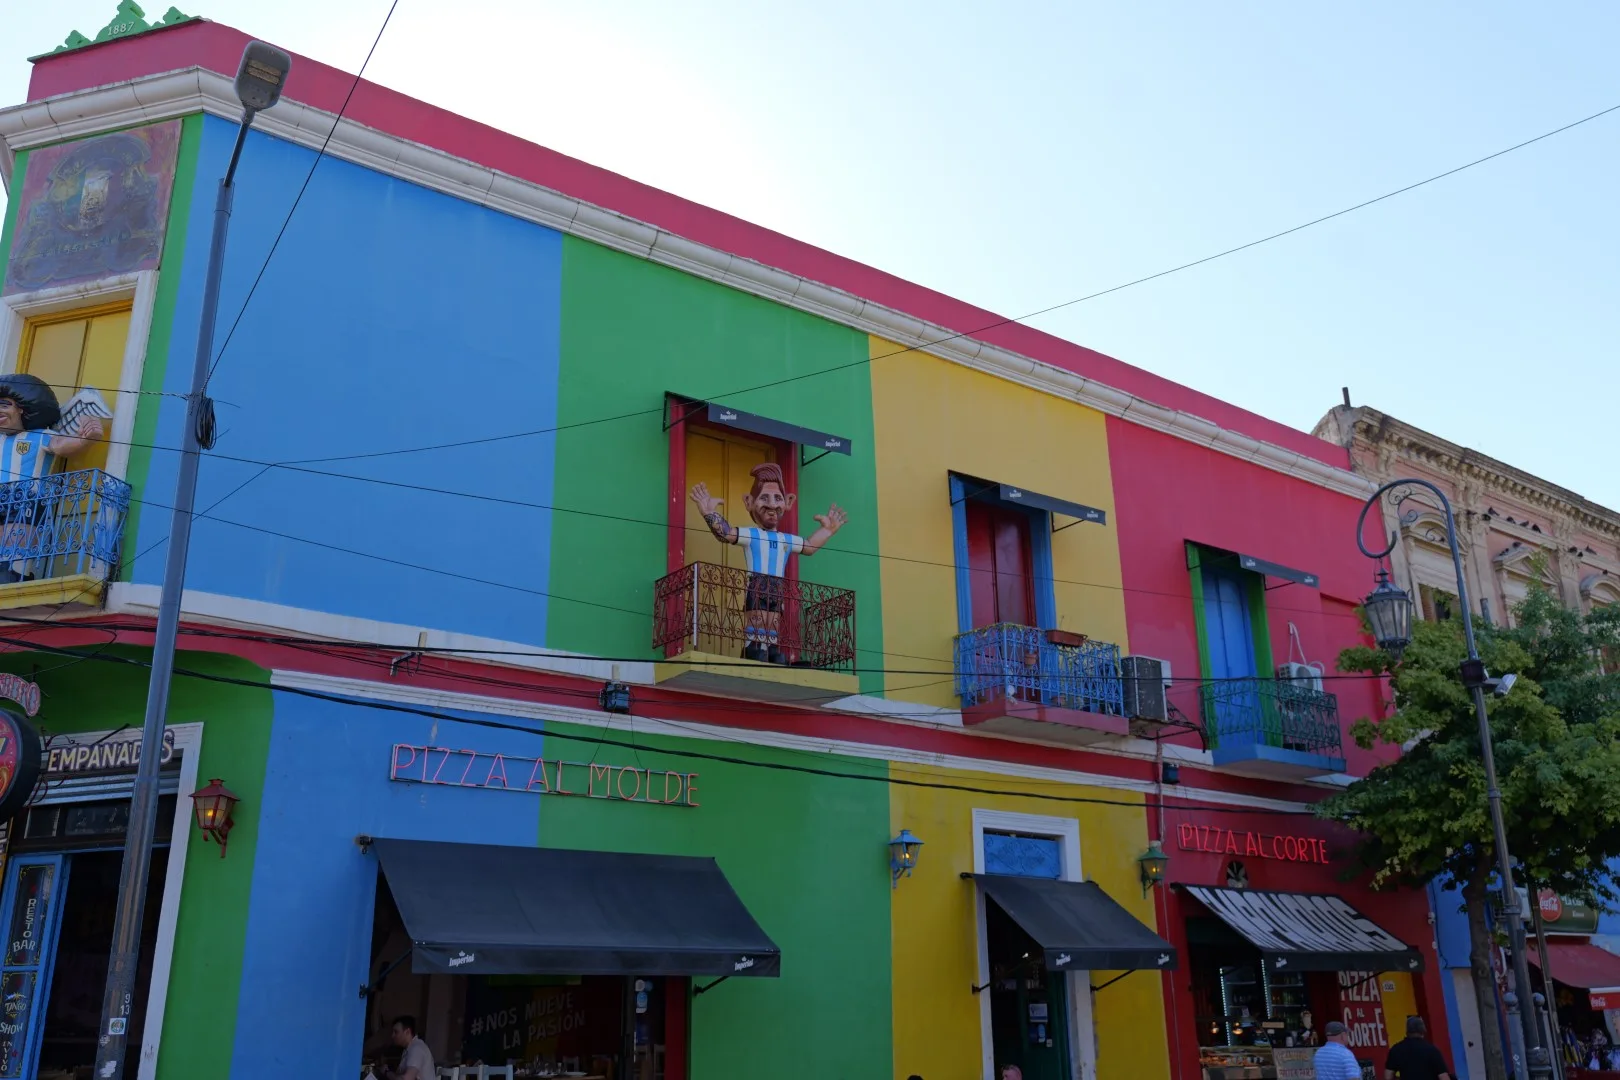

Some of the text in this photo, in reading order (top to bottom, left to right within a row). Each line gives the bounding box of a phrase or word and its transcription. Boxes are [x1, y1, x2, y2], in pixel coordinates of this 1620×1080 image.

[107, 21, 135, 36] 1887
[769, 541, 778, 549] 10
[47, 729, 174, 772] EMPANADS
[393, 744, 700, 807] PIZZA AL MOLDE
[1180, 823, 1330, 864] PIZZA AL CORTE
[23, 898, 37, 938] RESTO
[12, 940, 36, 953] BAR
[448, 953, 475, 967] Imperial
[734, 957, 754, 971] Imperial
[1338, 970, 1381, 1002] PIZZA
[124, 993, 131, 1004] 9
[5, 1001, 27, 1012] TANGO
[120, 1004, 130, 1015] 13
[1356, 1007, 1365, 1018] AL
[470, 991, 574, 1037] #NOS MUEVE
[0, 1021, 24, 1035] SHOW
[503, 1009, 587, 1050] LA PASIÓN
[1343, 1006, 1387, 1048] CORTE
